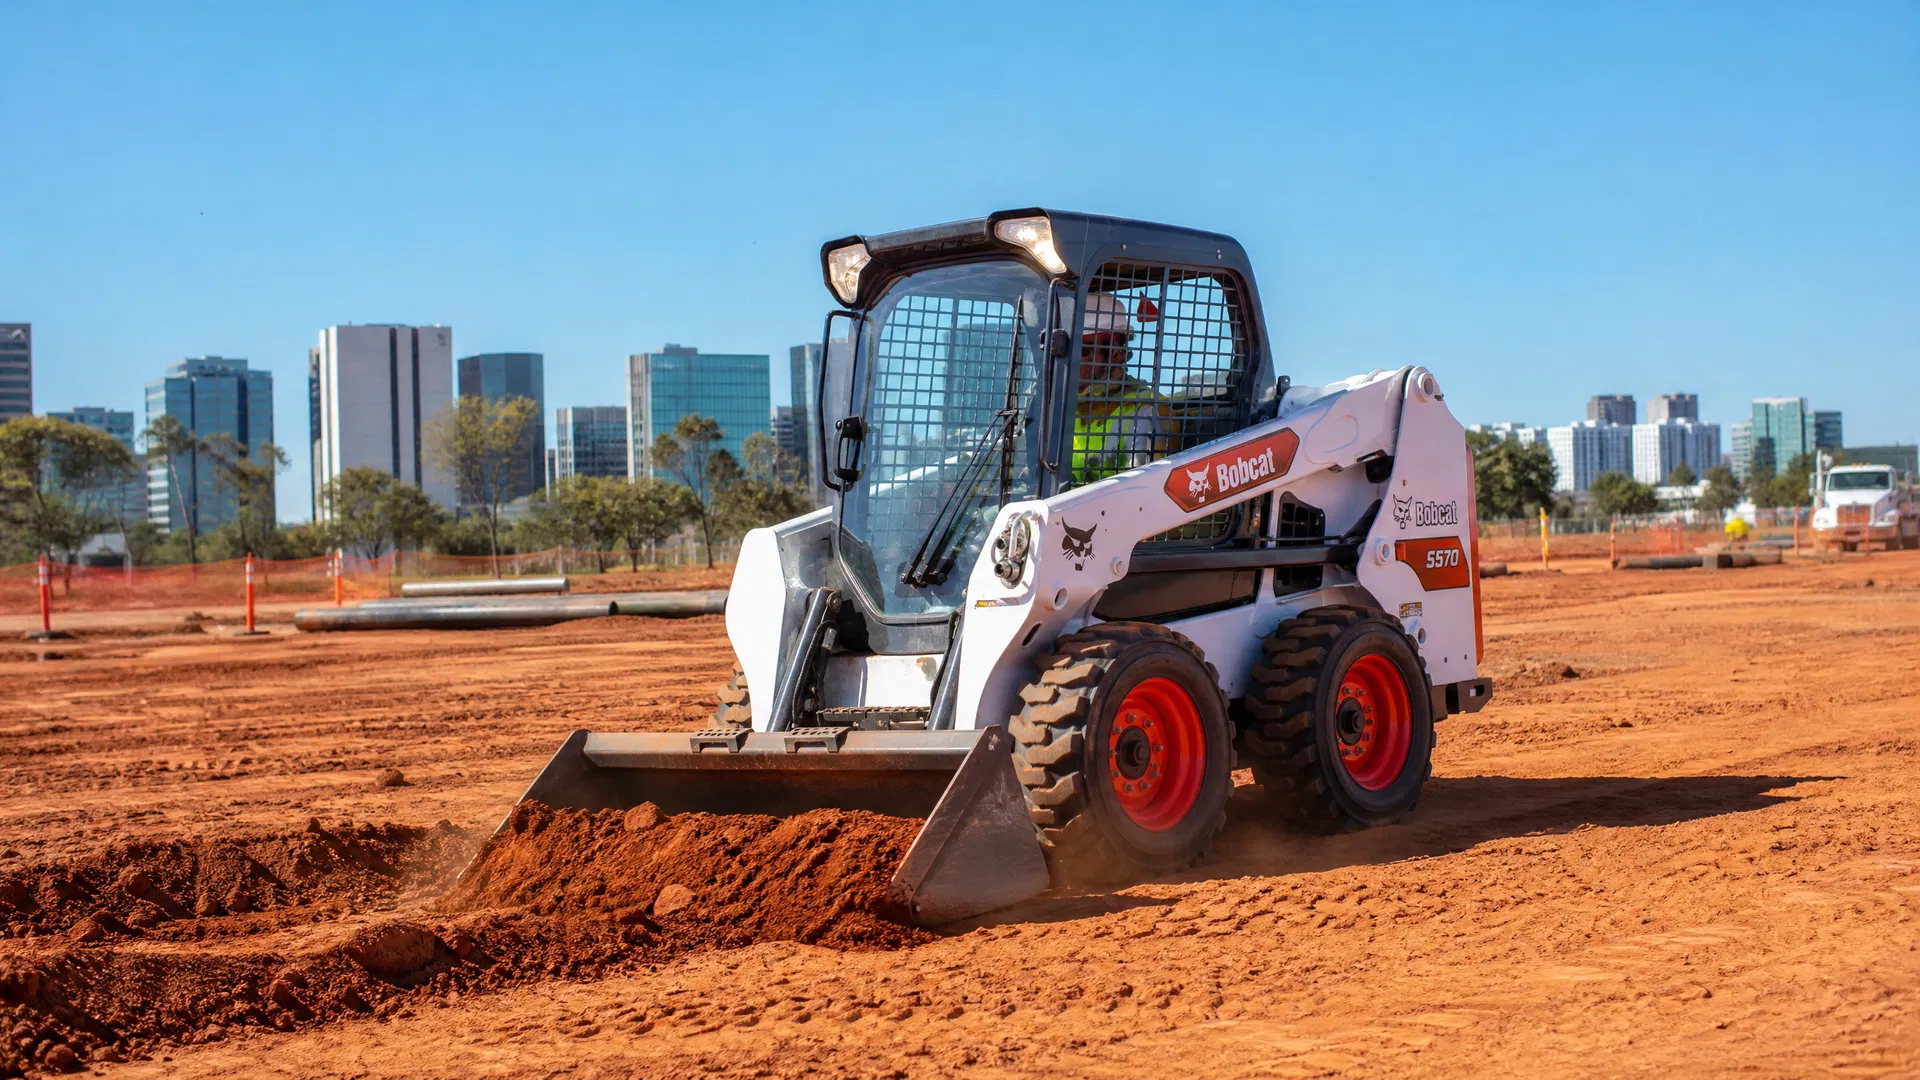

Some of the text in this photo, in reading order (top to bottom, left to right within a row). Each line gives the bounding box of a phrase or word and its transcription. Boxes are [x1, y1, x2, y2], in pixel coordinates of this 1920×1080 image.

[1216, 447, 1275, 493] Bobcat
[1415, 501, 1458, 526] Bobcat
[1426, 549, 1459, 569] S570
